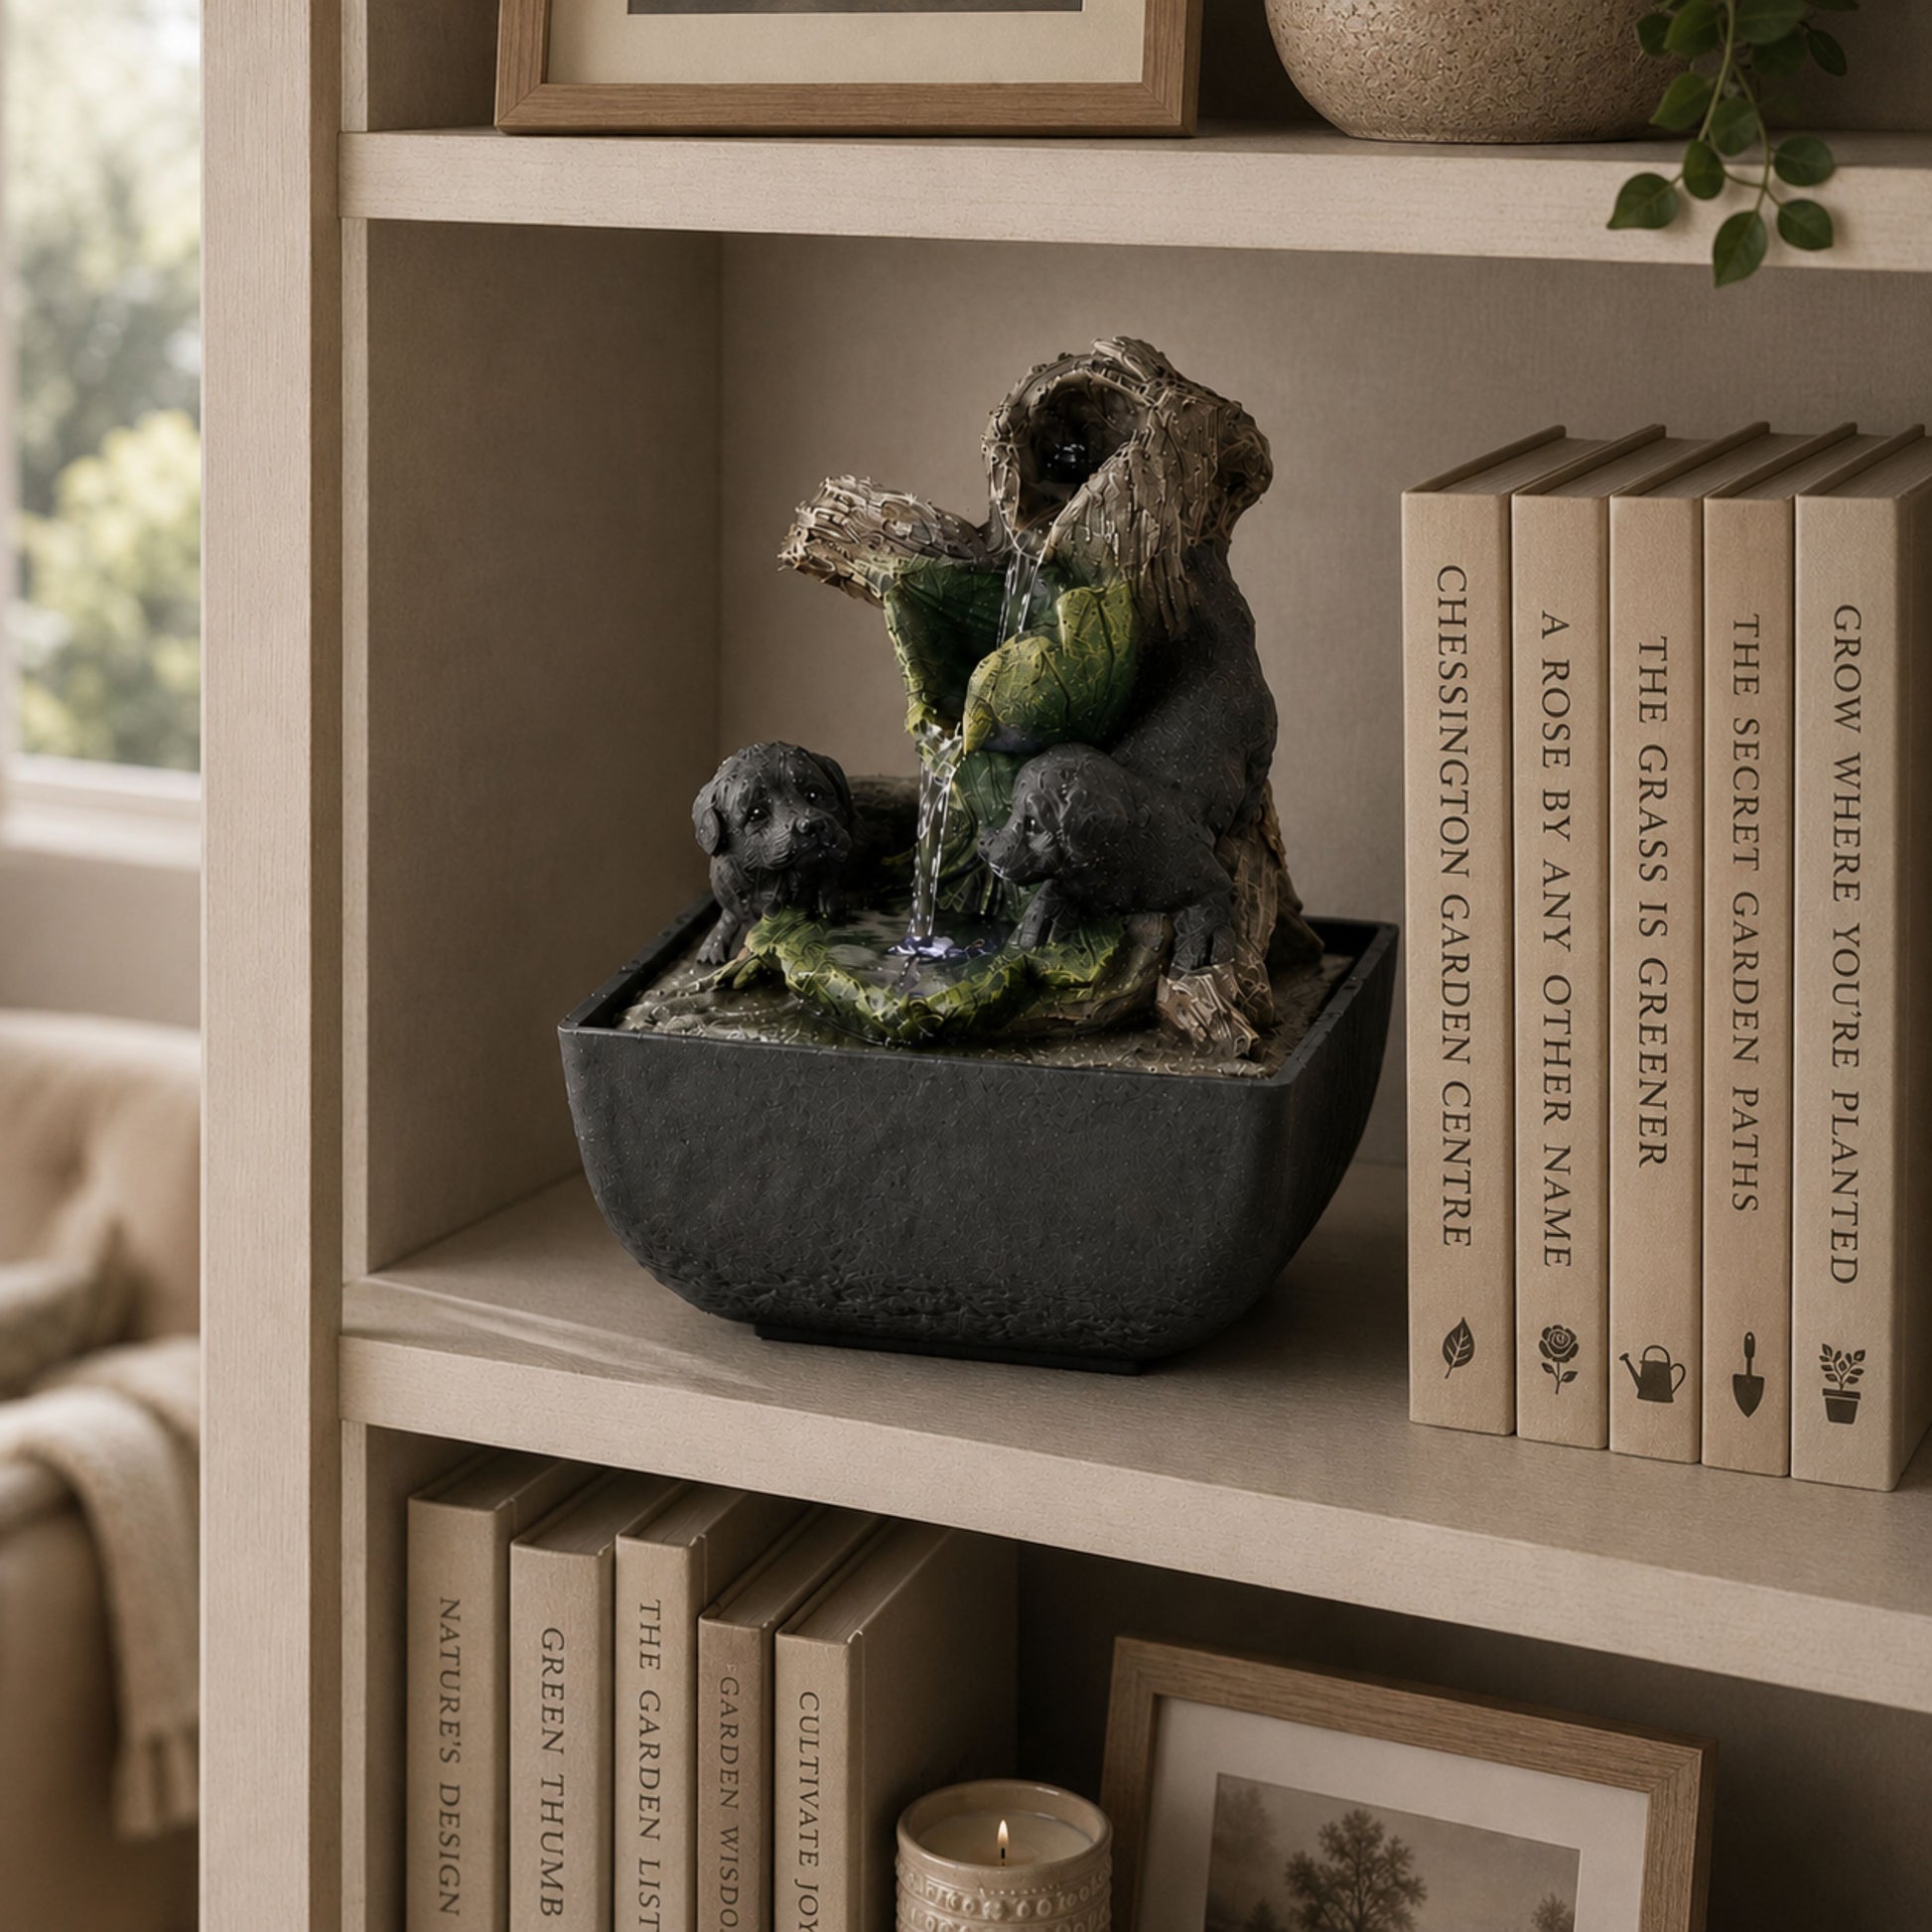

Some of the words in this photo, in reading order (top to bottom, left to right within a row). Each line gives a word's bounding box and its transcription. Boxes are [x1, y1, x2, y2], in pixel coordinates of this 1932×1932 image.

[1542, 609, 1571, 640] A
[1639, 634, 1669, 724] THE
[1732, 613, 1760, 697] THE
[1833, 604, 1863, 735] GROW
[1437, 565, 1469, 878] CHESSINGTON
[1542, 657, 1572, 769] ROSE
[1543, 787, 1572, 843] BY
[1638, 744, 1669, 883] GRASS
[1732, 717, 1761, 872] SECRET
[1832, 752, 1862, 902] WHERE
[1543, 857, 1572, 953] ANY
[1638, 900, 1669, 938] IS
[1440, 893, 1471, 1064] GARDEN
[1731, 891, 1760, 1064] GARDEN
[1831, 921, 1862, 1069] YOU'RE
[1543, 974, 1573, 1127] OTHER
[1638, 957, 1669, 1169] GREENER
[1442, 1080, 1472, 1246] CENTRE
[1544, 1143, 1573, 1268] NAME
[1730, 1085, 1759, 1212] PATHS
[1830, 1088, 1861, 1285] PLANTED
[439, 1597, 462, 1764] NATURE'S
[540, 1626, 565, 1755] GREEN
[638, 1598, 662, 1671] THE
[638, 1690, 662, 1842] GARDEN
[719, 1676, 740, 1810] GARDEN
[798, 1691, 820, 1867] CULTIVATE
[438, 1782, 462, 1917] DESIGN
[540, 1774, 565, 1917] THUMB
[637, 1858, 661, 1932] LIST
[719, 1826, 740, 1932] WISDO
